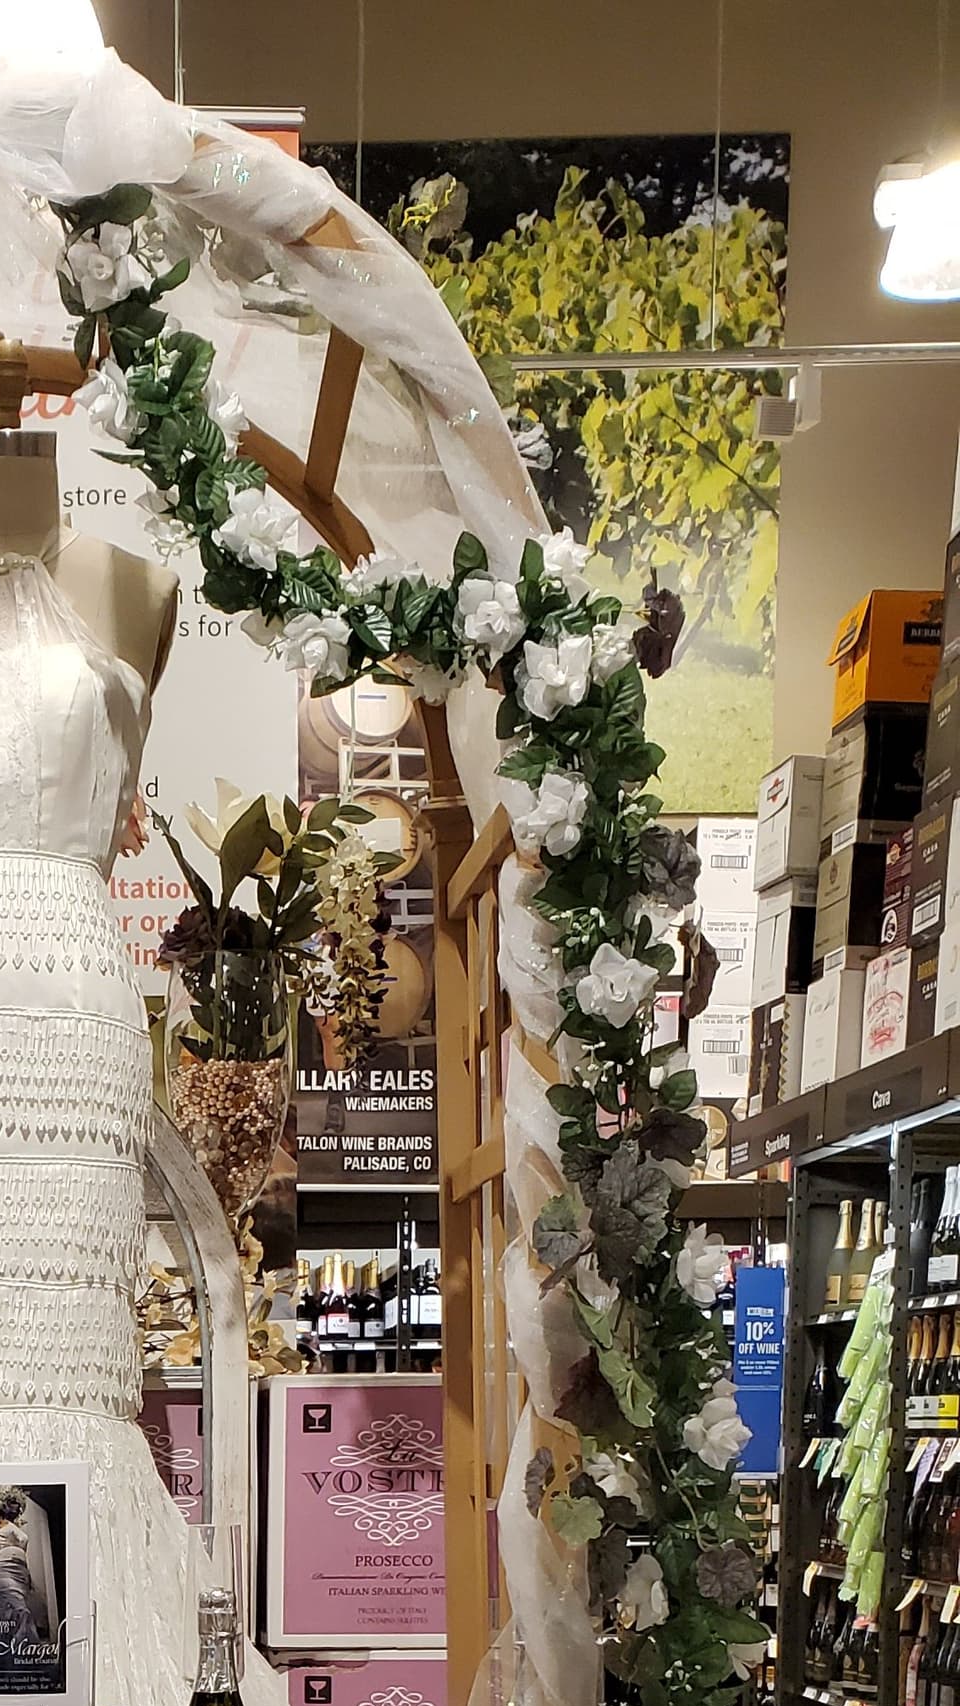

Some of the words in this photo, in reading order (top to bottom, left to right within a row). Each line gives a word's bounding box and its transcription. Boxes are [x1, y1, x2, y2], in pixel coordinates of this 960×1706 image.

[199, 619, 233, 636] for
[370, 1069, 434, 1091] EALES
[345, 1096, 433, 1111] WINEMAKERS
[872, 1090, 891, 1110] Cava
[341, 1136, 375, 1150] WINE
[378, 1136, 433, 1150] BRANDS
[765, 1133, 790, 1157] Sparkling
[343, 1156, 410, 1173] PALISADE,
[413, 1156, 432, 1170] CO
[745, 1321, 775, 1342] 10%
[738, 1343, 754, 1355] OFF
[756, 1343, 780, 1355] WINE
[355, 1555, 433, 1567] PROSECCO
[328, 1587, 370, 1596] ITALIAN
[371, 1587, 428, 1596] SPARKLING
[431, 1587, 446, 1596] WI
